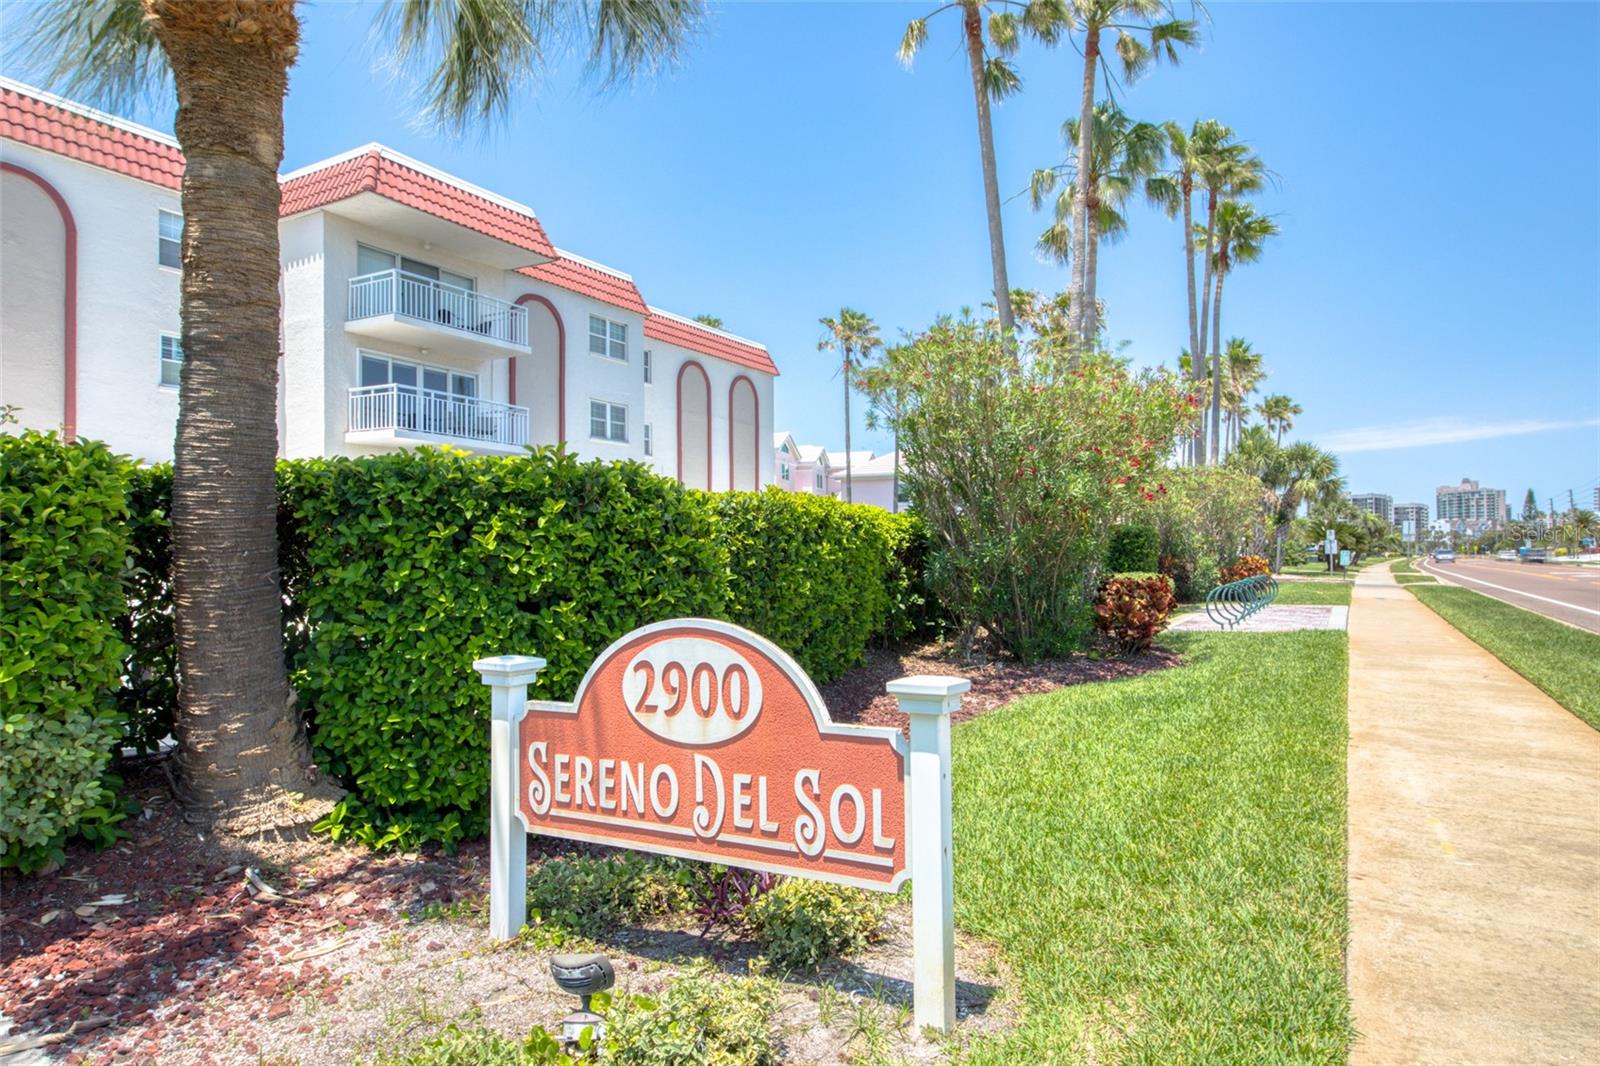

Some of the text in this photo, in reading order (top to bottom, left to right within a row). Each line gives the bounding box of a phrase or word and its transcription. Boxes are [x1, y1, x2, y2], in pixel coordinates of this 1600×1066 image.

[632, 659, 750, 721] 2900
[527, 740, 897, 857] SERENO DEL SOL
